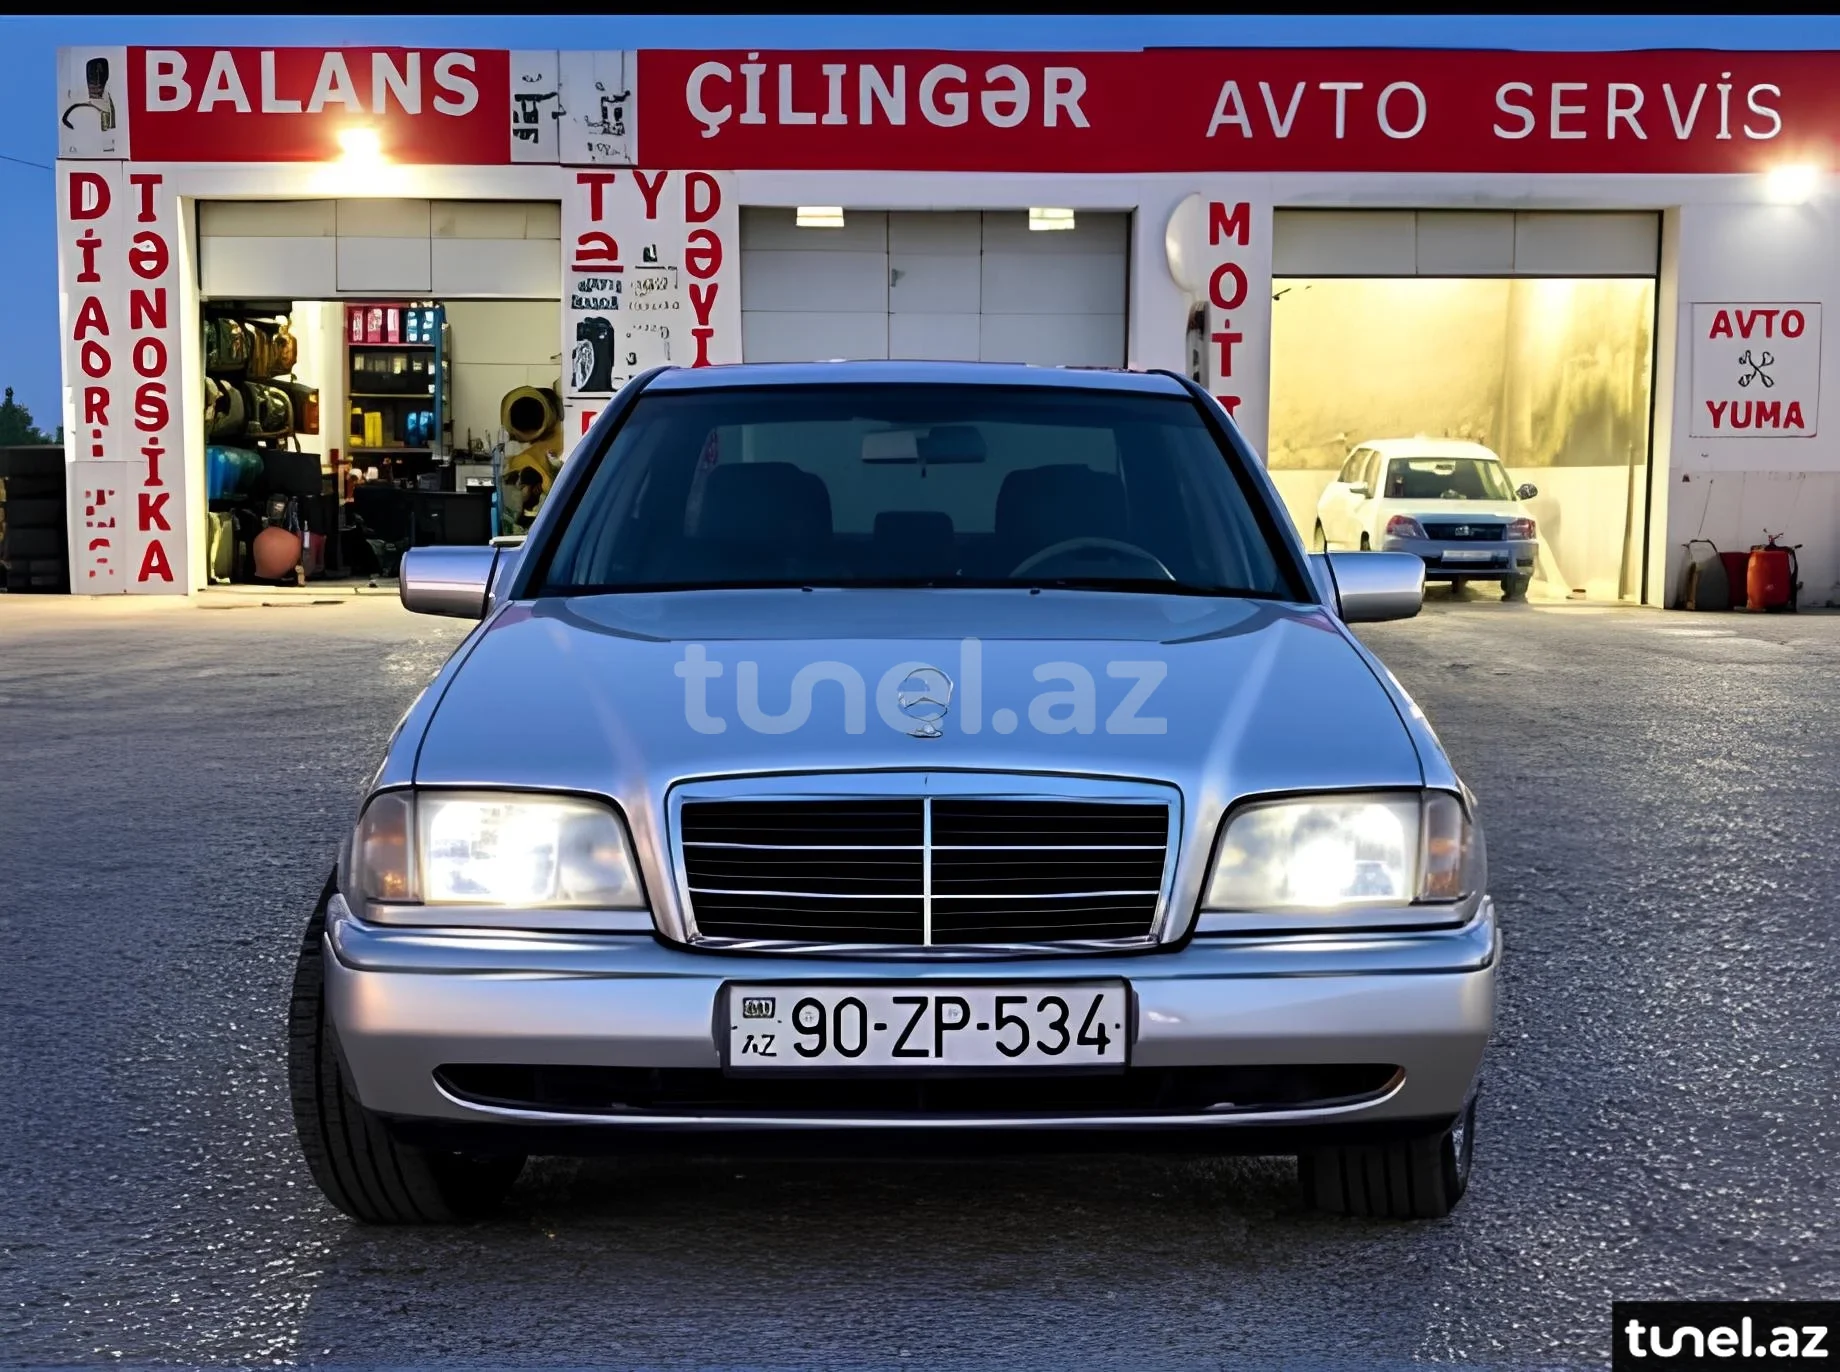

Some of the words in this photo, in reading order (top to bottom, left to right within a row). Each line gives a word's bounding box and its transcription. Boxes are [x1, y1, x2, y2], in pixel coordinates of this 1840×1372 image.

[146, 50, 479, 116] BALANS
[1206, 80, 1427, 139] AVTO
[1493, 72, 1782, 139] SERVİS
[1709, 309, 1805, 339] AVTO
[1706, 400, 1804, 429] YUMA
[792, 994, 1111, 1059] 90-ZP-534
